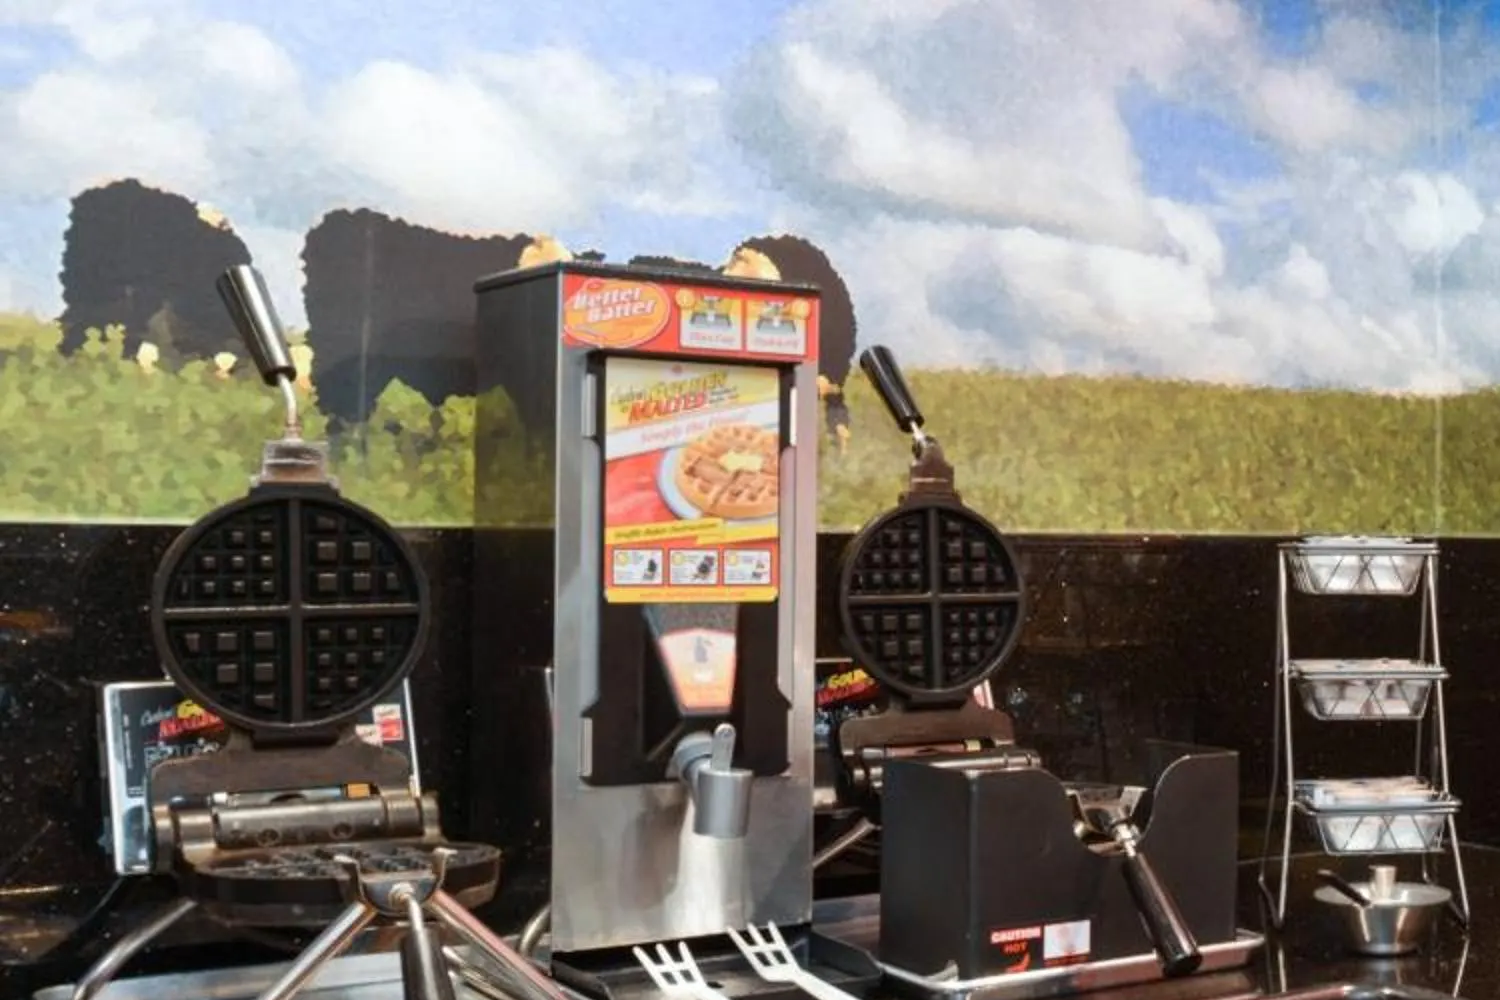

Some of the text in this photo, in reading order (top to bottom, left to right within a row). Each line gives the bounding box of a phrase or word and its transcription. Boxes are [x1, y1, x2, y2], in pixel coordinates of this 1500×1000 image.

[573, 287, 642, 310] Better
[586, 299, 656, 323] Batter
[990, 926, 1042, 945] CAUTION
[1003, 941, 1028, 955] HOT
